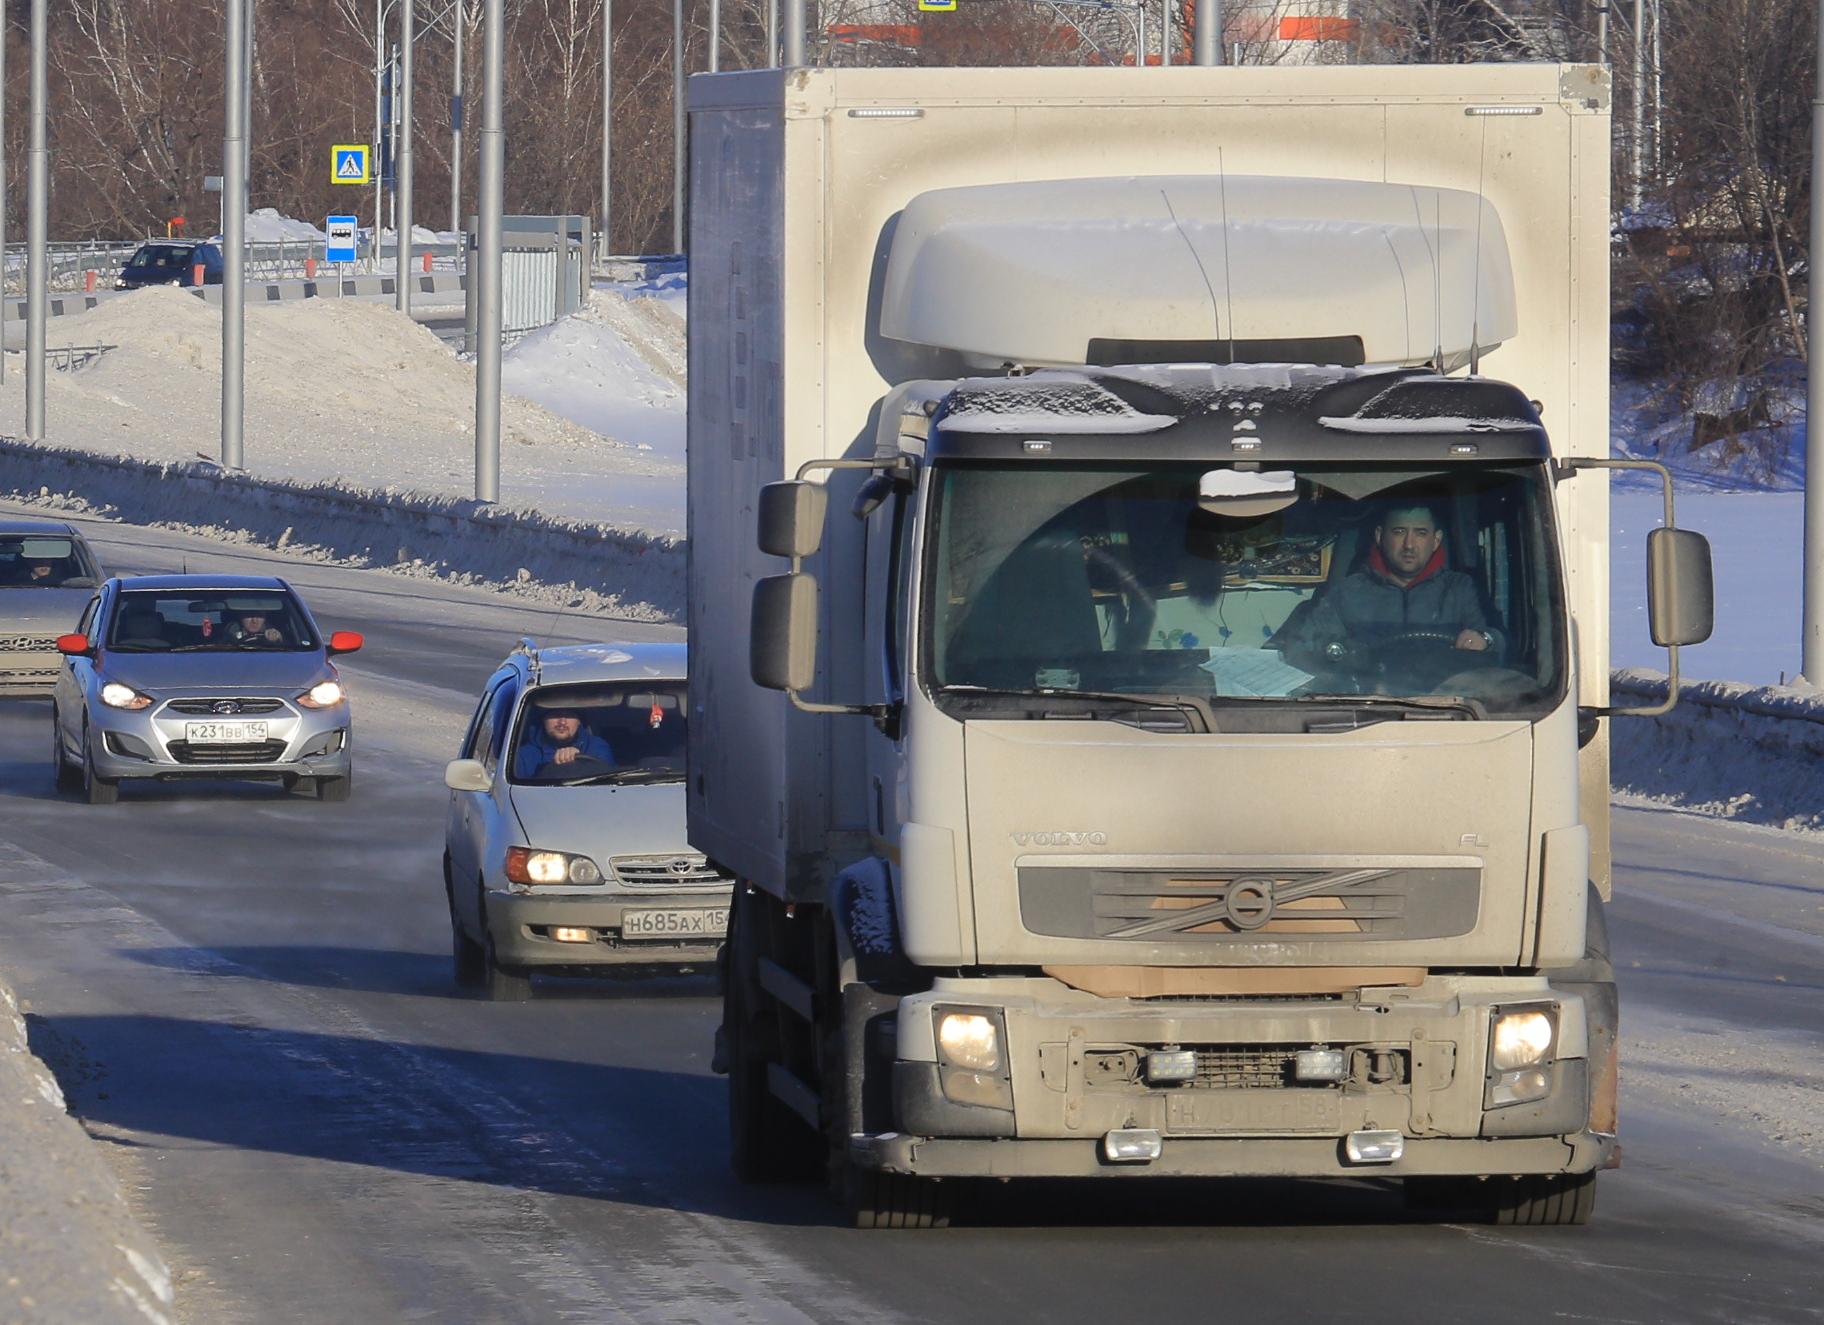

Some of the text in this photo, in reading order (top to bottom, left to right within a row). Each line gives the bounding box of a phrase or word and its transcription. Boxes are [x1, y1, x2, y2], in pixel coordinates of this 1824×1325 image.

[191, 725, 242, 738] К231ВВ
[1008, 831, 1106, 846] VOLVO
[630, 913, 702, 931] Н685АХ
